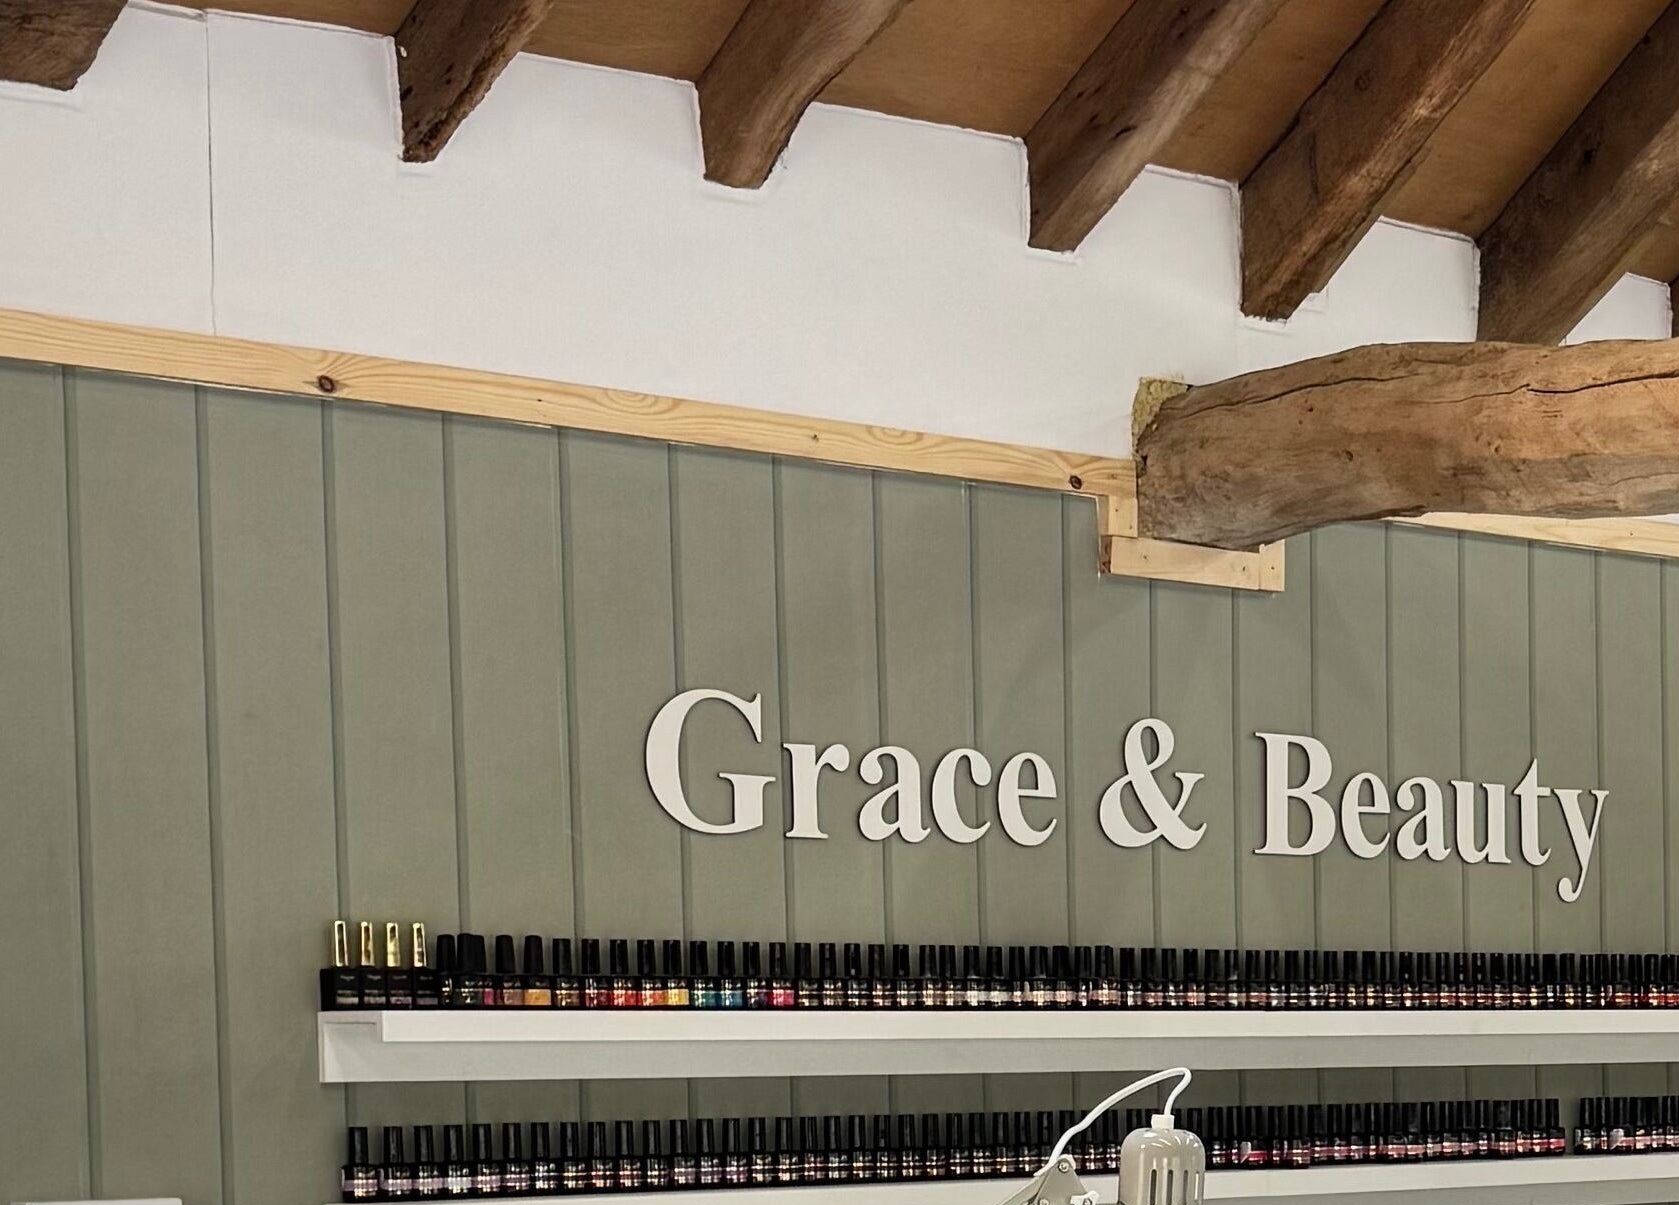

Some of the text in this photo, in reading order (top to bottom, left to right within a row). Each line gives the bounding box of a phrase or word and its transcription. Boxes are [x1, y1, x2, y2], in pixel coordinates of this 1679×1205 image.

[645, 688, 1610, 903] Grace & Beauty
